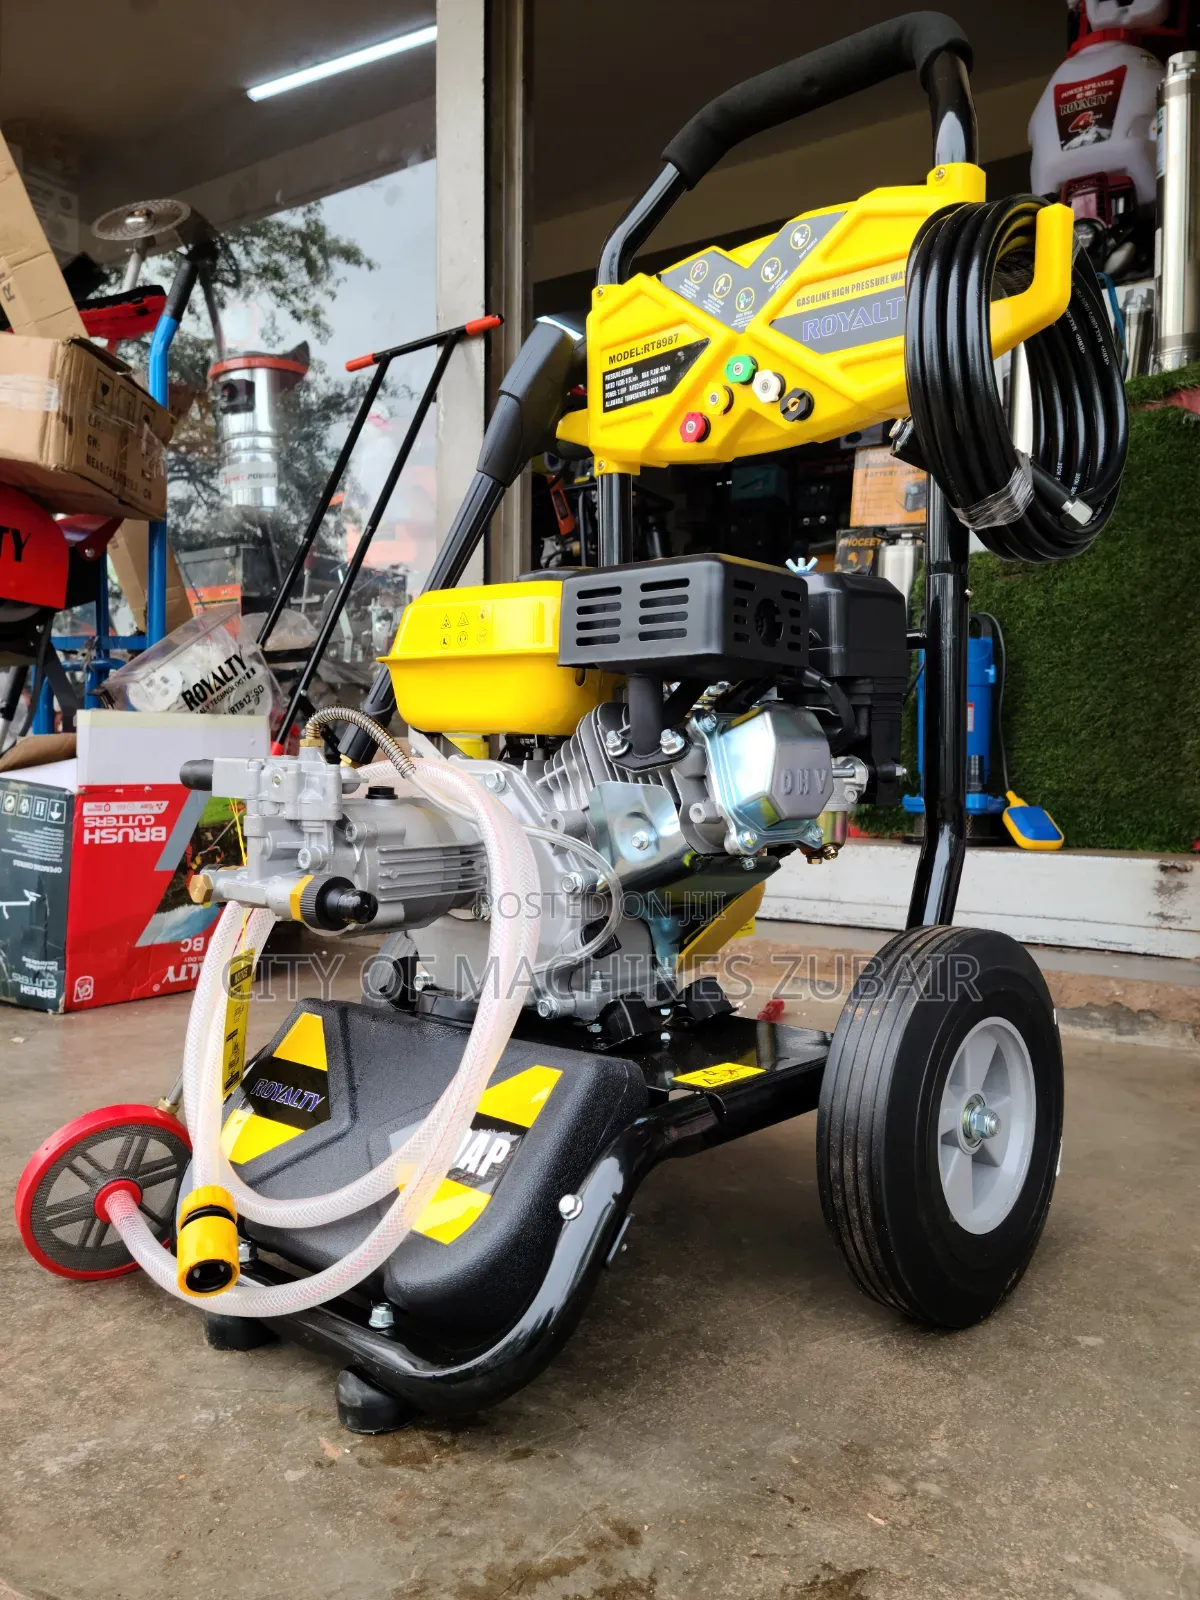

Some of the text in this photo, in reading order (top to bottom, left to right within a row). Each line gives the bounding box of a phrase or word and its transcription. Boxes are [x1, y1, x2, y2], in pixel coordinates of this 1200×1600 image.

[796, 290, 831, 308] GASOLINE
[832, 286, 850, 298] HIGH
[851, 275, 889, 294] PRESSURE
[802, 296, 906, 341] ROYALT
[608, 332, 680, 366] MODEL:RT8987
[181, 648, 247, 712] ROYALTY
[209, 676, 247, 707] TECHNOLOGY
[83, 815, 155, 828] CUTTERS
[83, 826, 167, 845] BRUSH
[180, 937, 205, 953] BC
[12, 972, 57, 989] CUTTERS
[20, 984, 57, 999] BRUSH
[250, 1078, 326, 1113] ROYALTY
